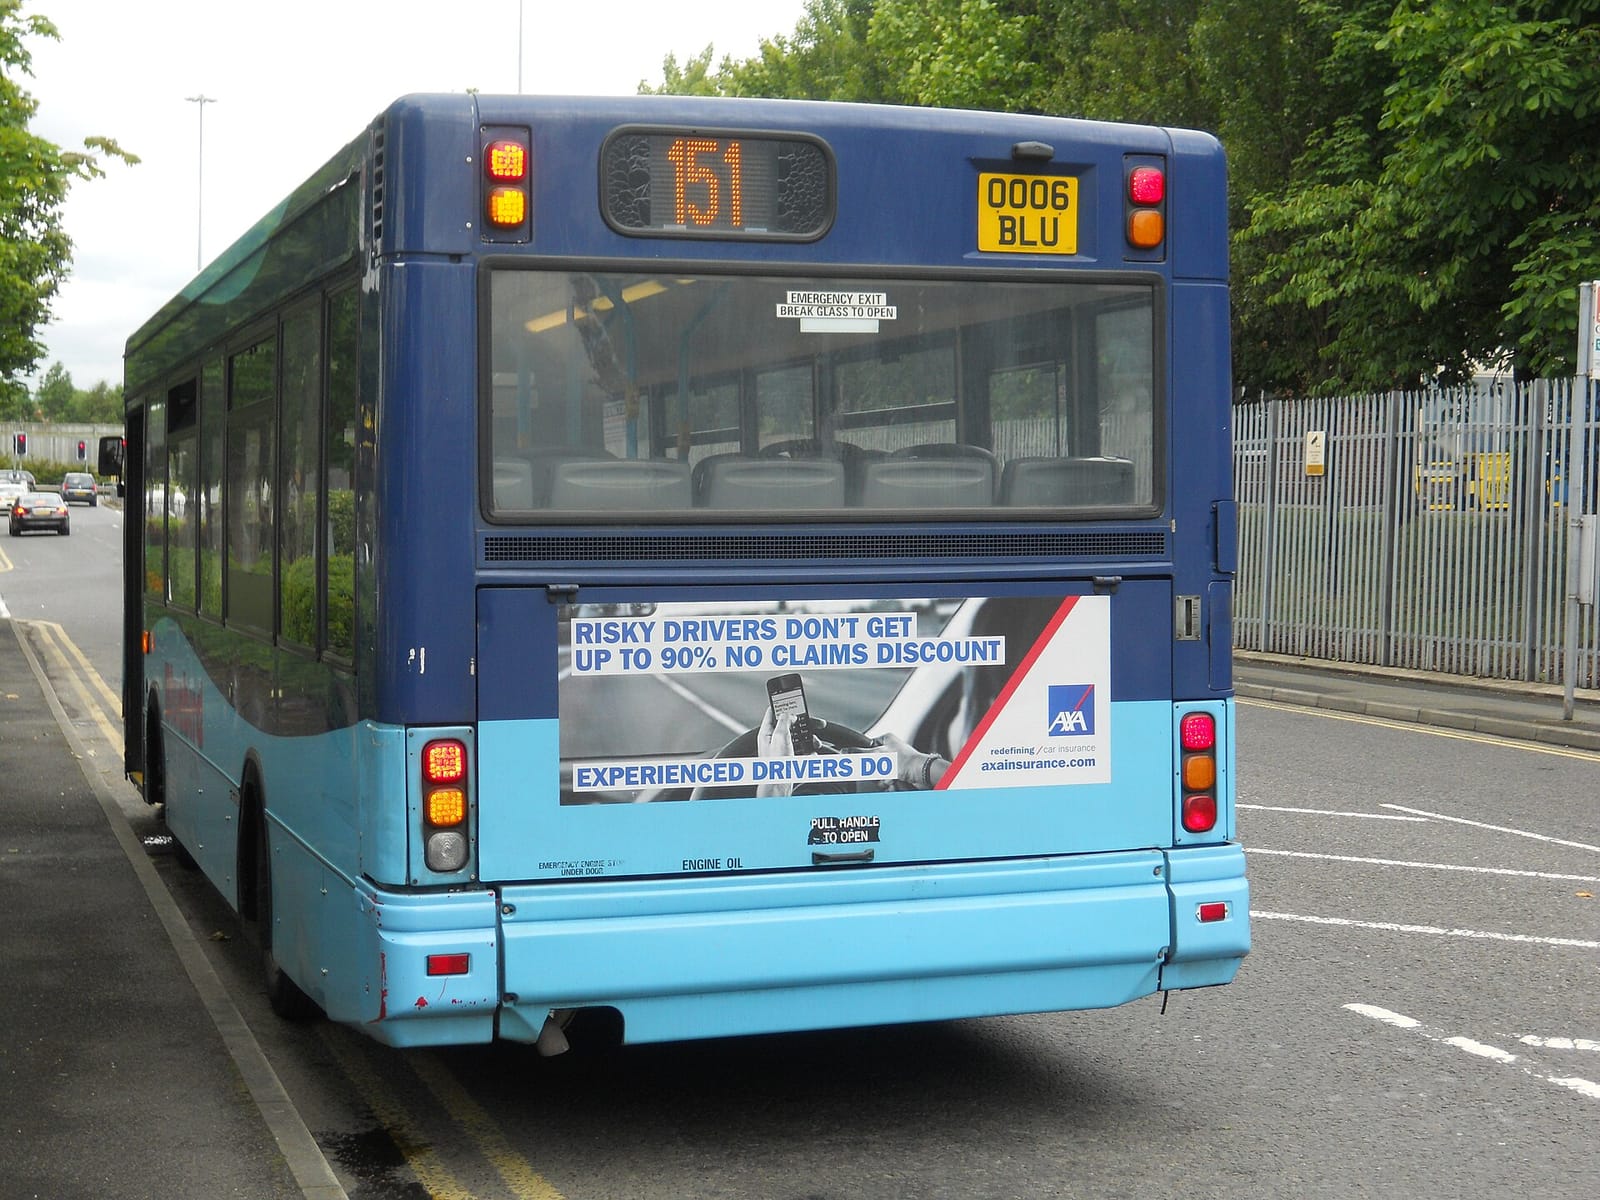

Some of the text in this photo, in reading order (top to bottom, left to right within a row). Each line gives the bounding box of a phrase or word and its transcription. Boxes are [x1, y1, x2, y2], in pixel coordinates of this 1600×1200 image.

[667, 139, 742, 227] 151
[998, 215, 1058, 246] BLU
[791, 292, 882, 305] EMERGENCY EXIT
[780, 306, 894, 318] BREAK GLASS TO OPEN
[575, 616, 913, 644] RISKY DRIVERS DON'T GET
[575, 640, 1001, 671] UP TO 90% NO CLAIMS DISCOUNT
[1049, 710, 1088, 732] AXA
[990, 746, 1035, 755] redefining
[1058, 744, 1096, 753] insurance
[981, 758, 1096, 771] axainsurance.com
[577, 756, 893, 788] EXPERIENCED DRIVERS DO
[811, 815, 879, 830] PULL HANDLE
[822, 830, 868, 843] TO OPEN
[682, 858, 743, 870] ENGINE OIL
[561, 868, 584, 876] UNDER
